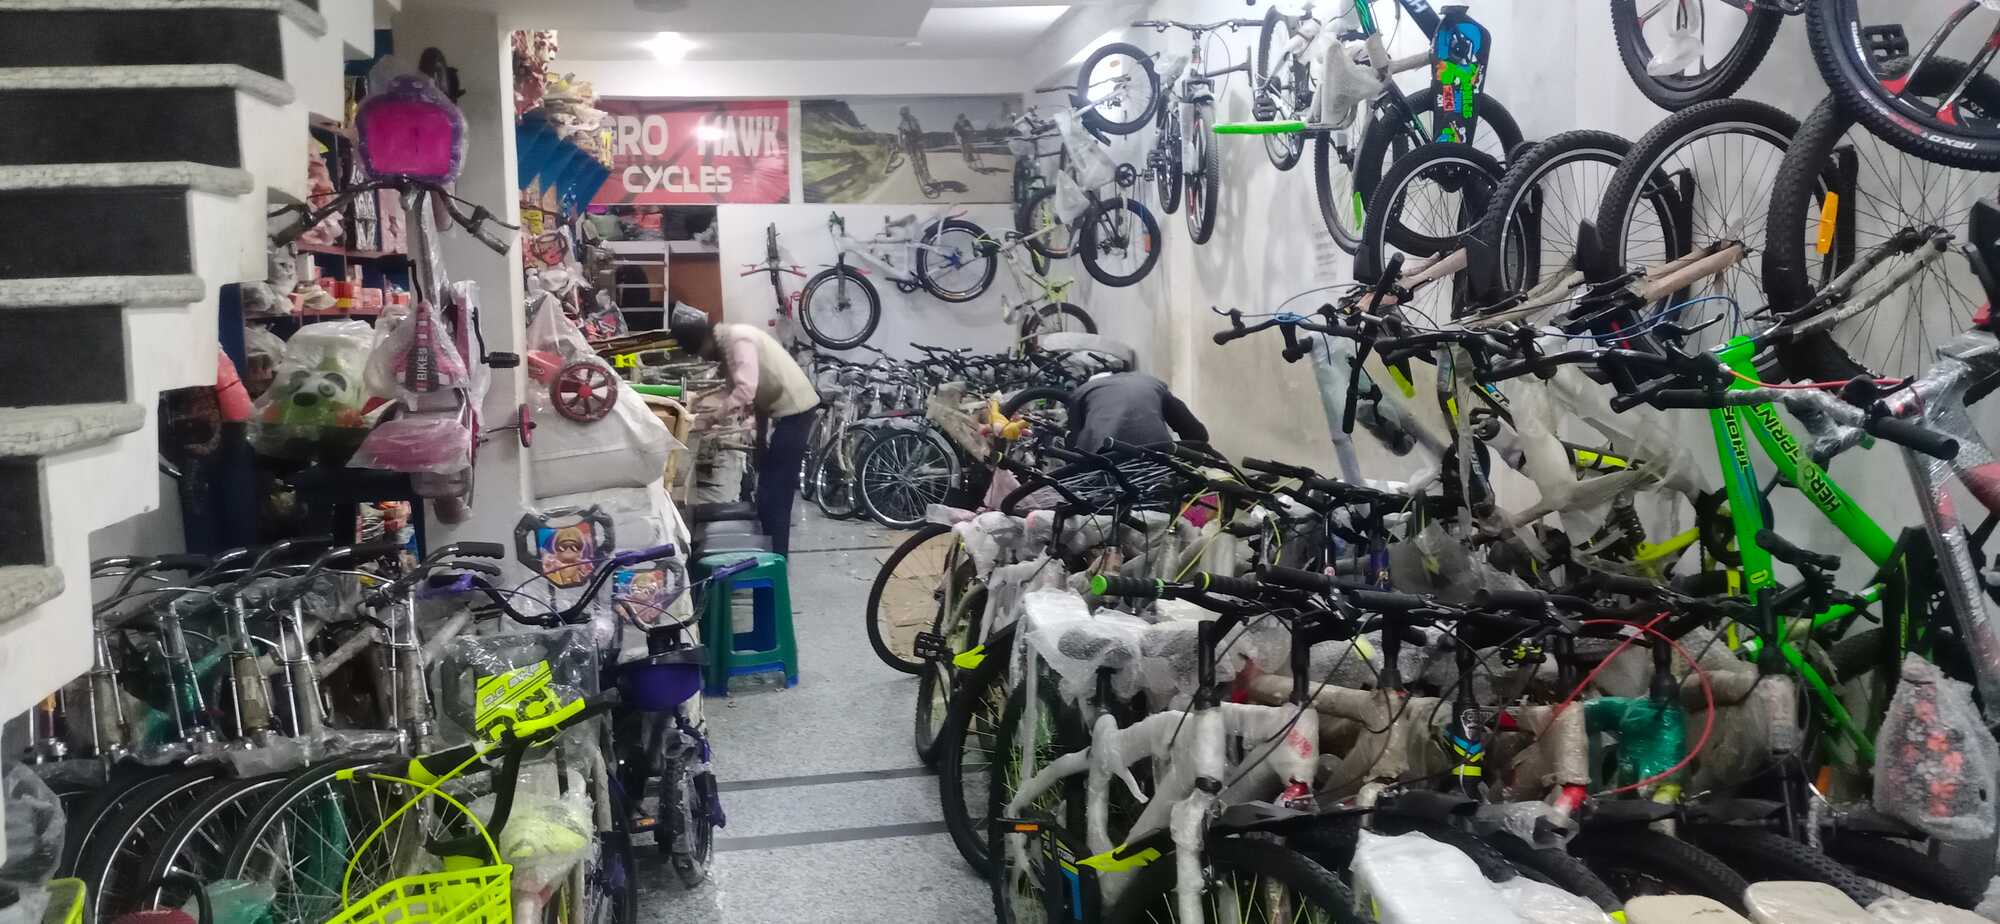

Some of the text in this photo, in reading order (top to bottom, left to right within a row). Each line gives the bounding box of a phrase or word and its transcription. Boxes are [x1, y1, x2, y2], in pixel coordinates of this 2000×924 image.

[697, 115, 780, 157] HAWK
[622, 165, 733, 193] CYCLES
[416, 347, 428, 380] BIKES
[1802, 463, 1841, 514] HERO
